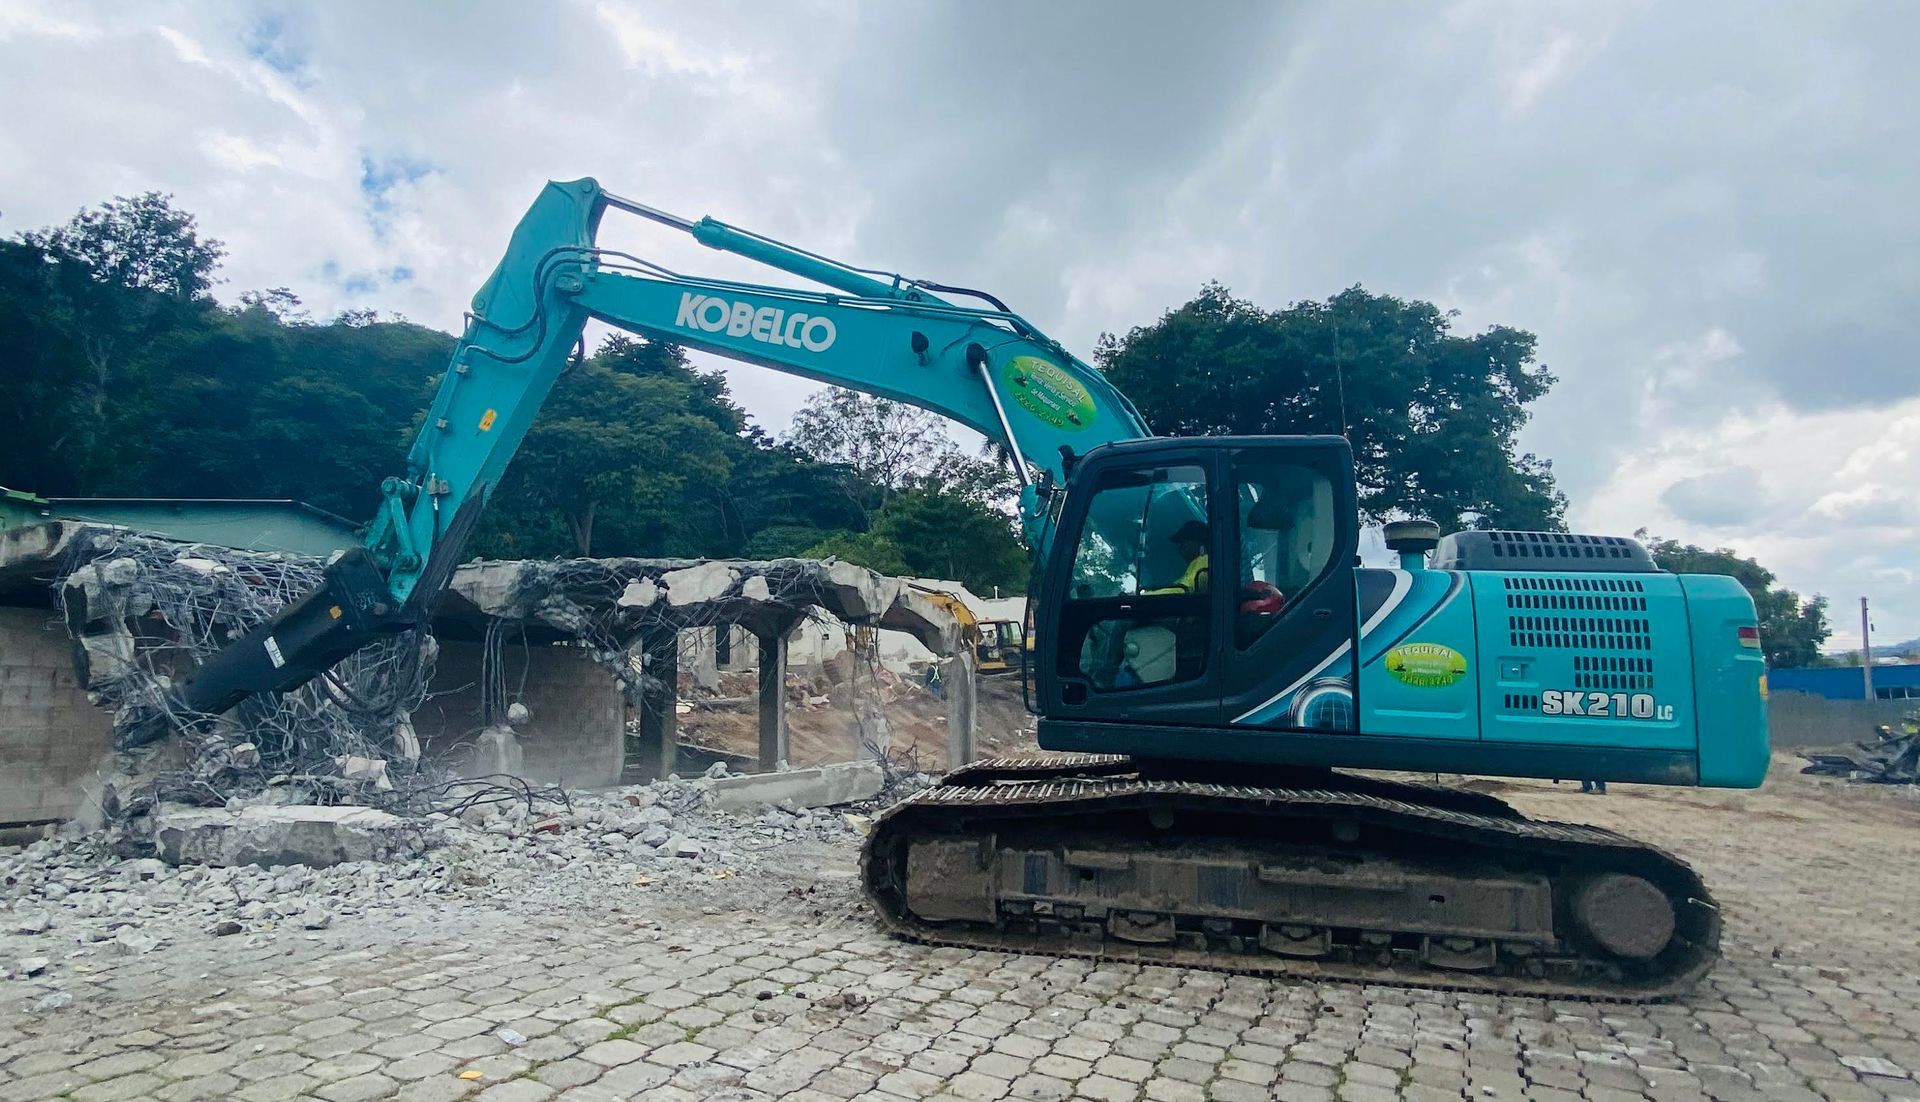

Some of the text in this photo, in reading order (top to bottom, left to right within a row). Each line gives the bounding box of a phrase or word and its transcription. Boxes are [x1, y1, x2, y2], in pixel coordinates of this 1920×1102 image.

[675, 292, 837, 352] KOBELCO
[1030, 360, 1085, 403] TEQUISAL
[1398, 645, 1452, 658] TEQUISAL
[1542, 690, 1673, 720] SK210 LC
